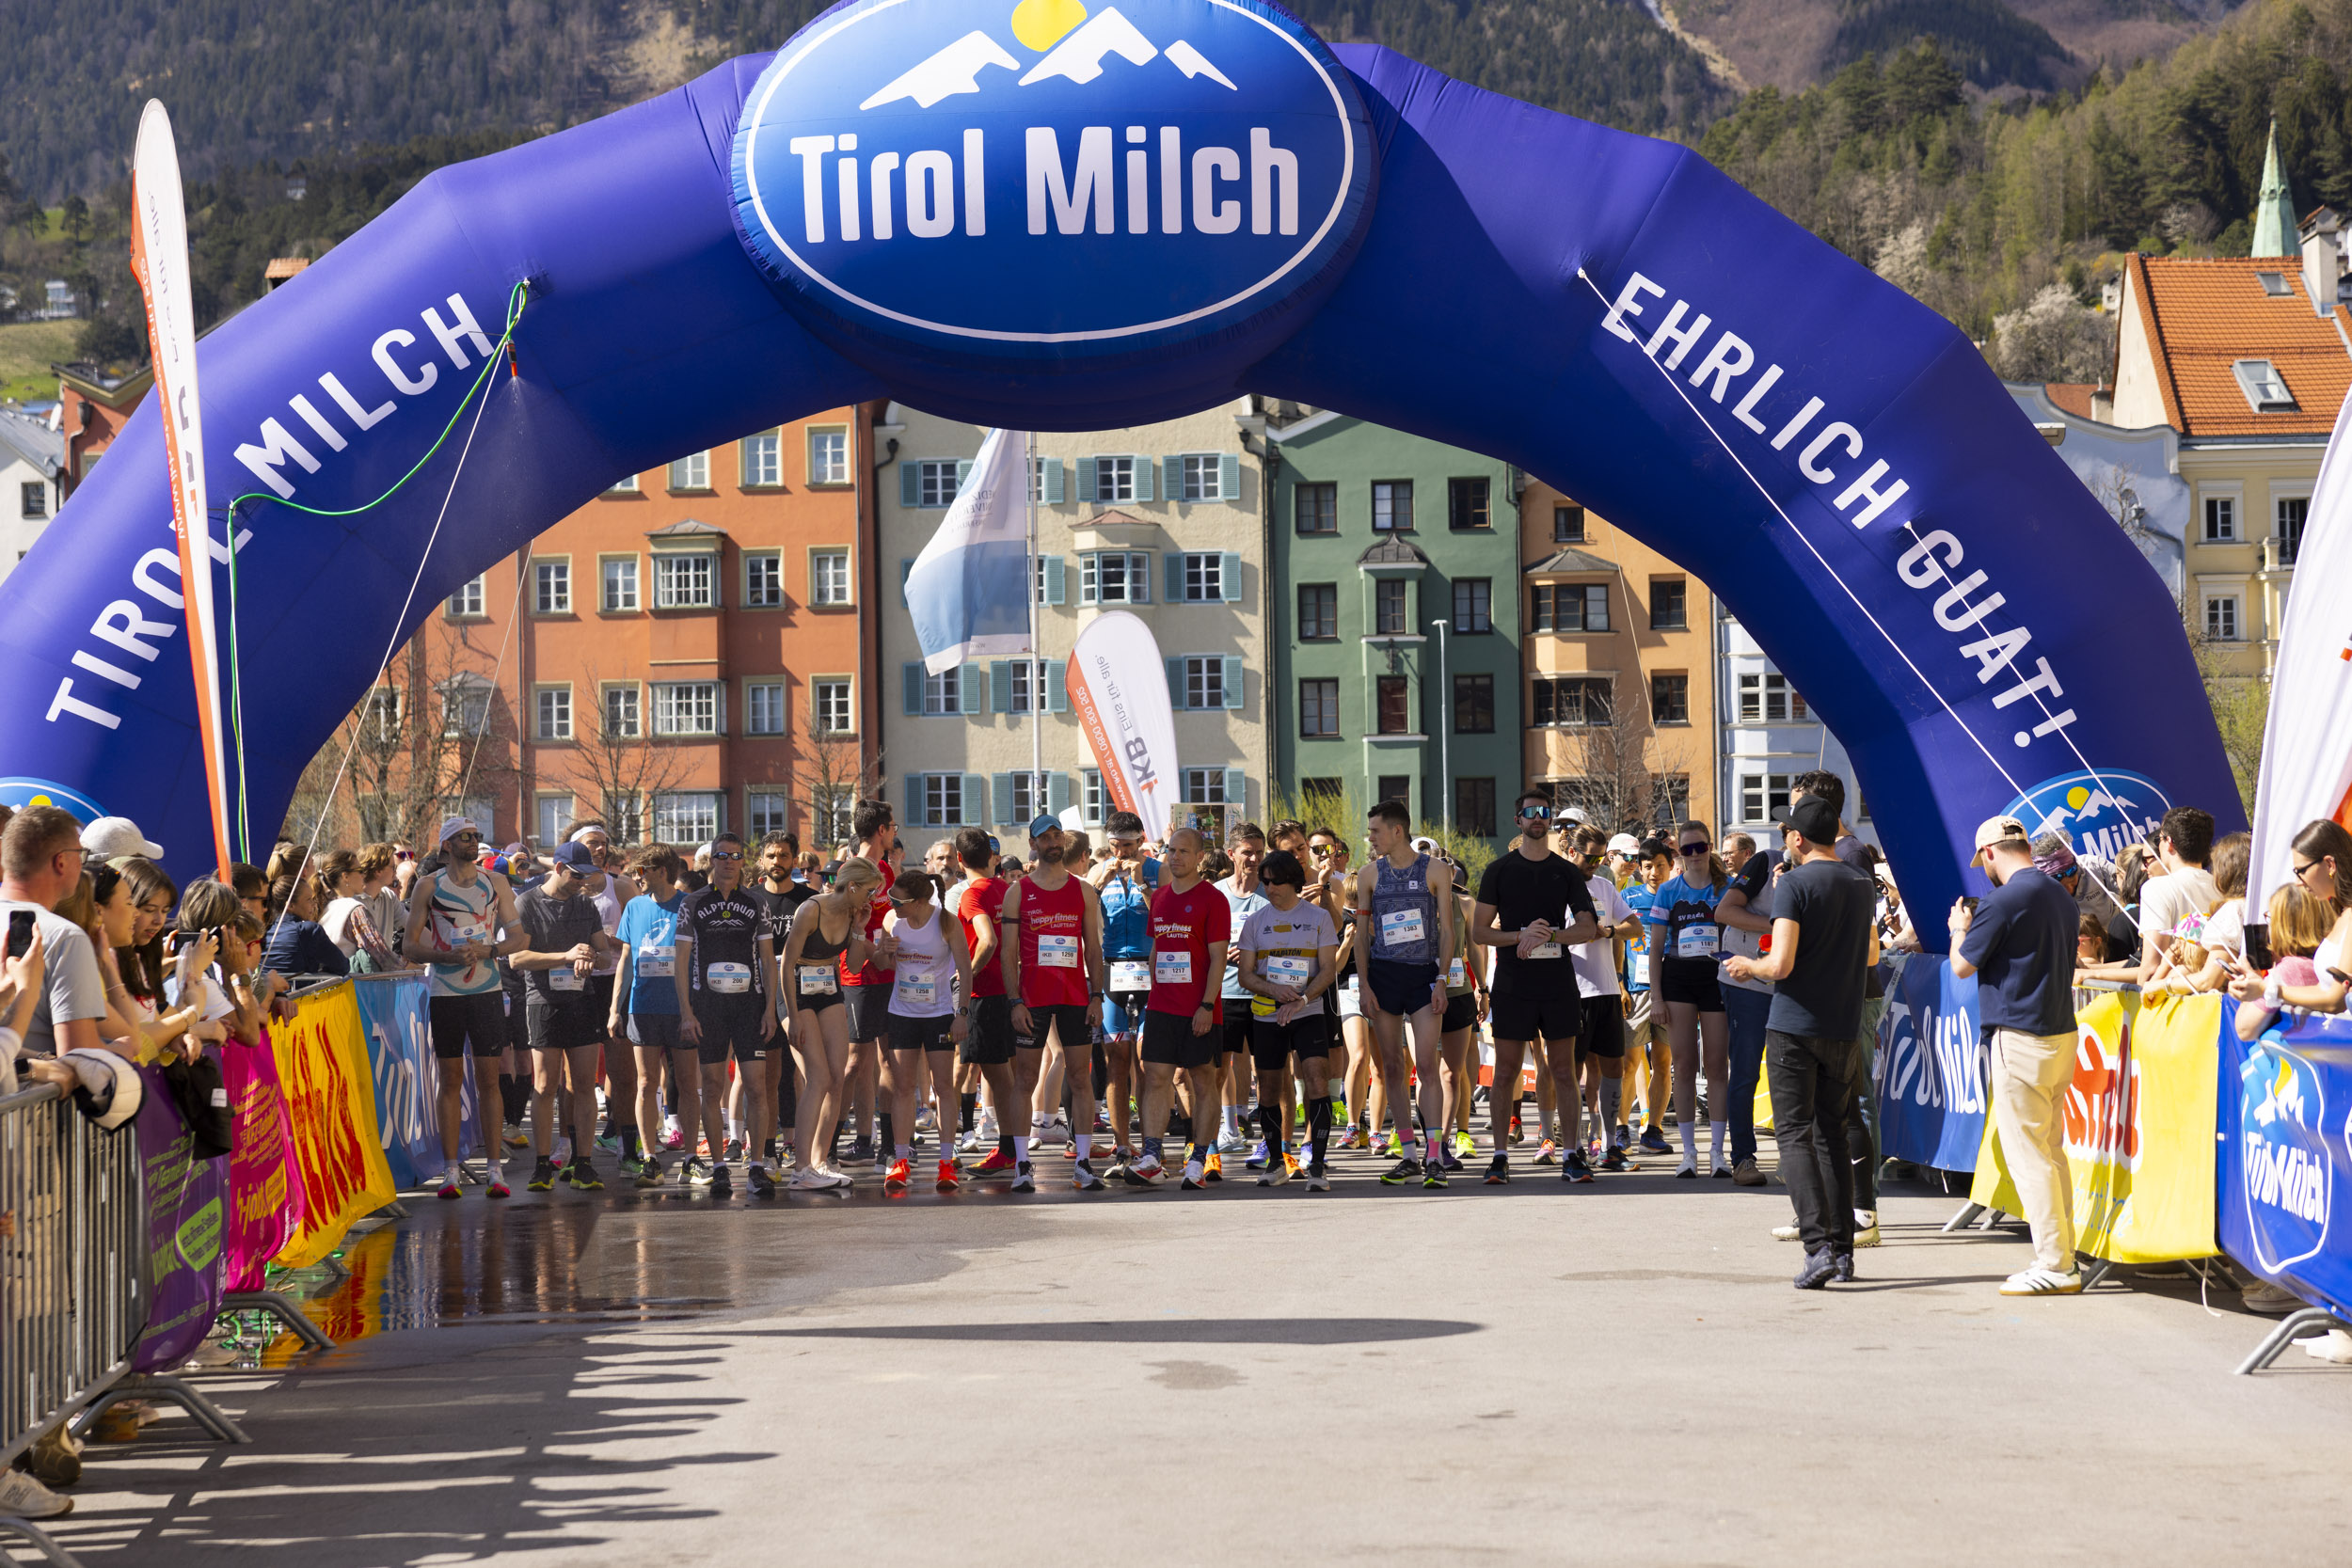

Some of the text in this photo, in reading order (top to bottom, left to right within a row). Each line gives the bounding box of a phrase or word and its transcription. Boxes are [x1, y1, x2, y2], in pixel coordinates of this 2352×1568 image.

[789, 126, 1298, 243] Tirol Milch
[233, 293, 494, 499] MILCH
[1601, 272, 2077, 749] EHRLICH GUAT!
[697, 901, 755, 920] ALPTRAUM
[1030, 912, 1078, 925] happy fitness
[2085, 889, 2101, 902] Team
